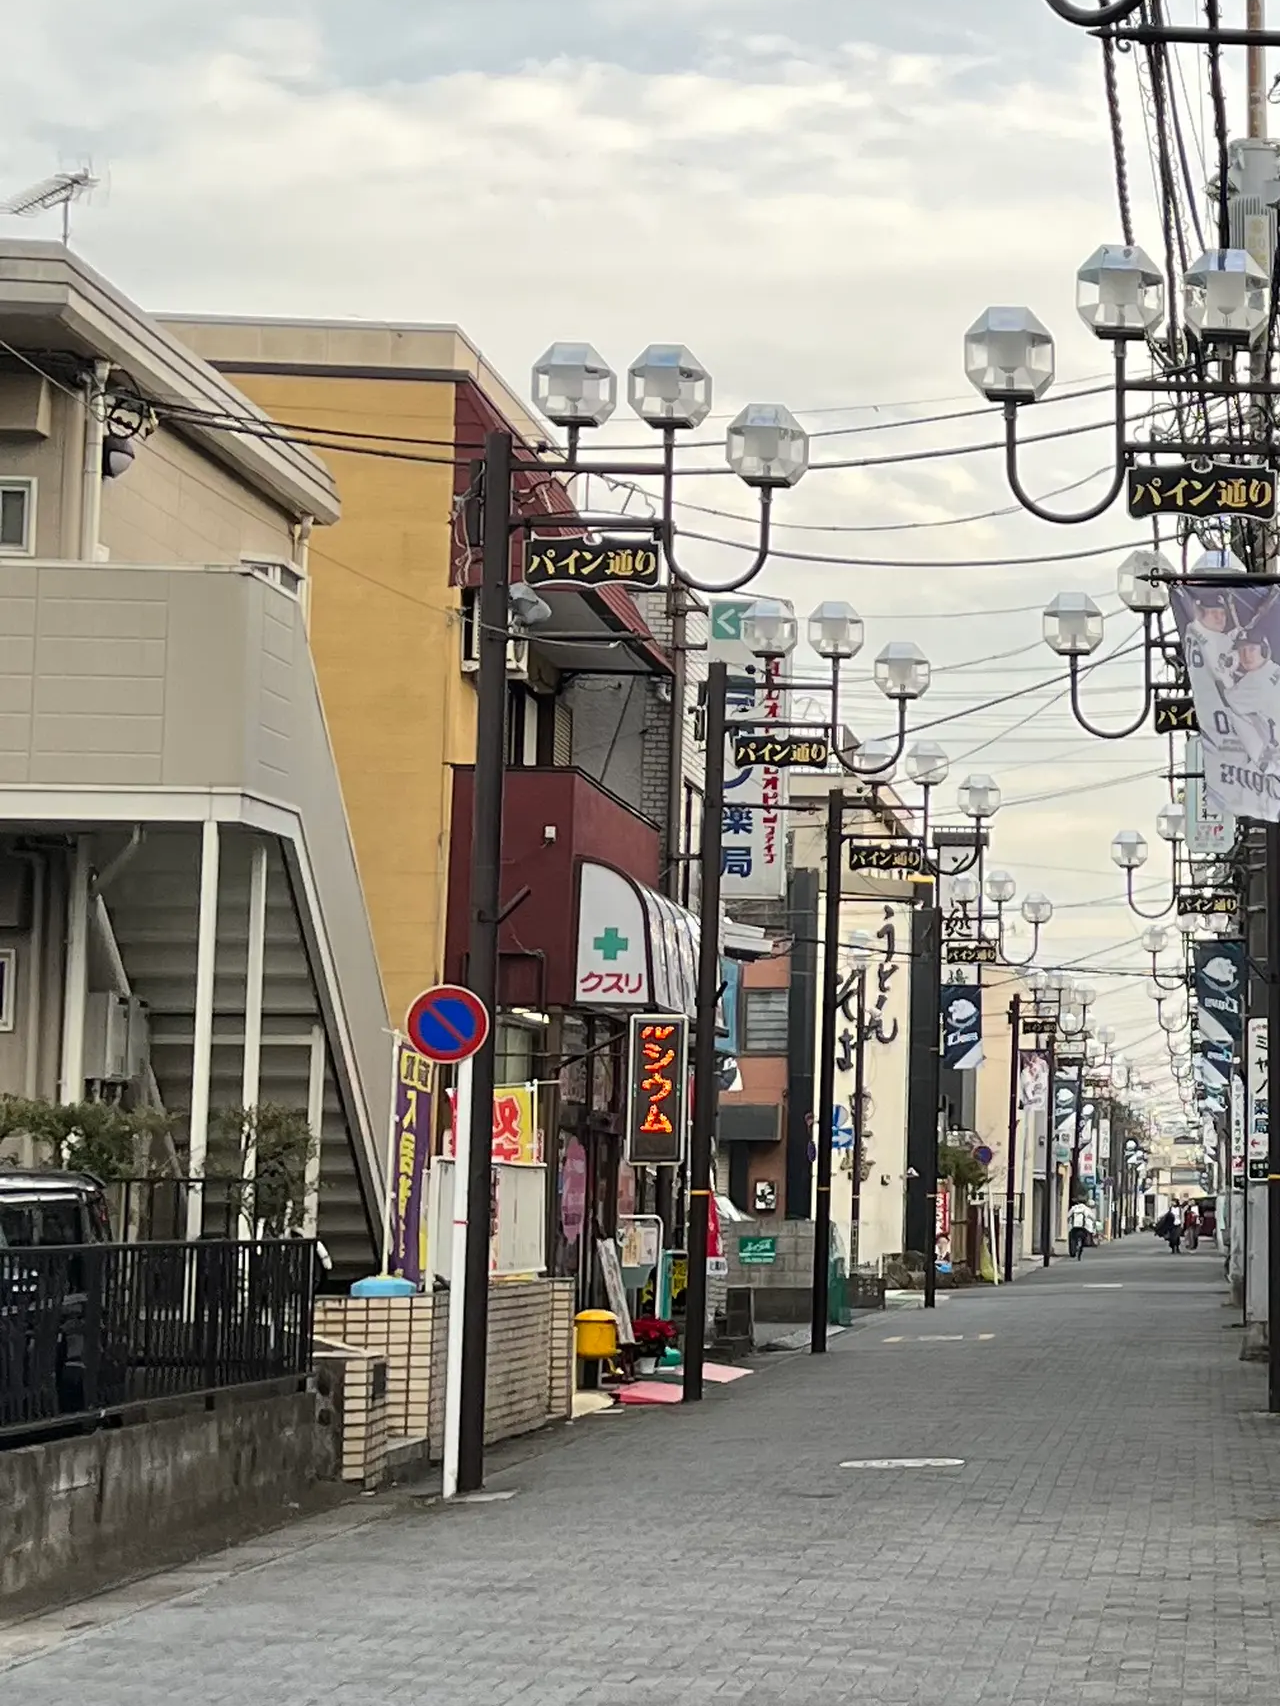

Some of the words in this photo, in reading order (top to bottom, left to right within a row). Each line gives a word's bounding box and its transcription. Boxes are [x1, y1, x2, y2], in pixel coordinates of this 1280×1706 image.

[1131, 475, 1273, 509] パイン通り
[527, 549, 657, 578] パイン通り
[736, 742, 828, 765] パイン通り
[851, 848, 921, 869] パイン通り
[579, 971, 643, 994] クスリ
